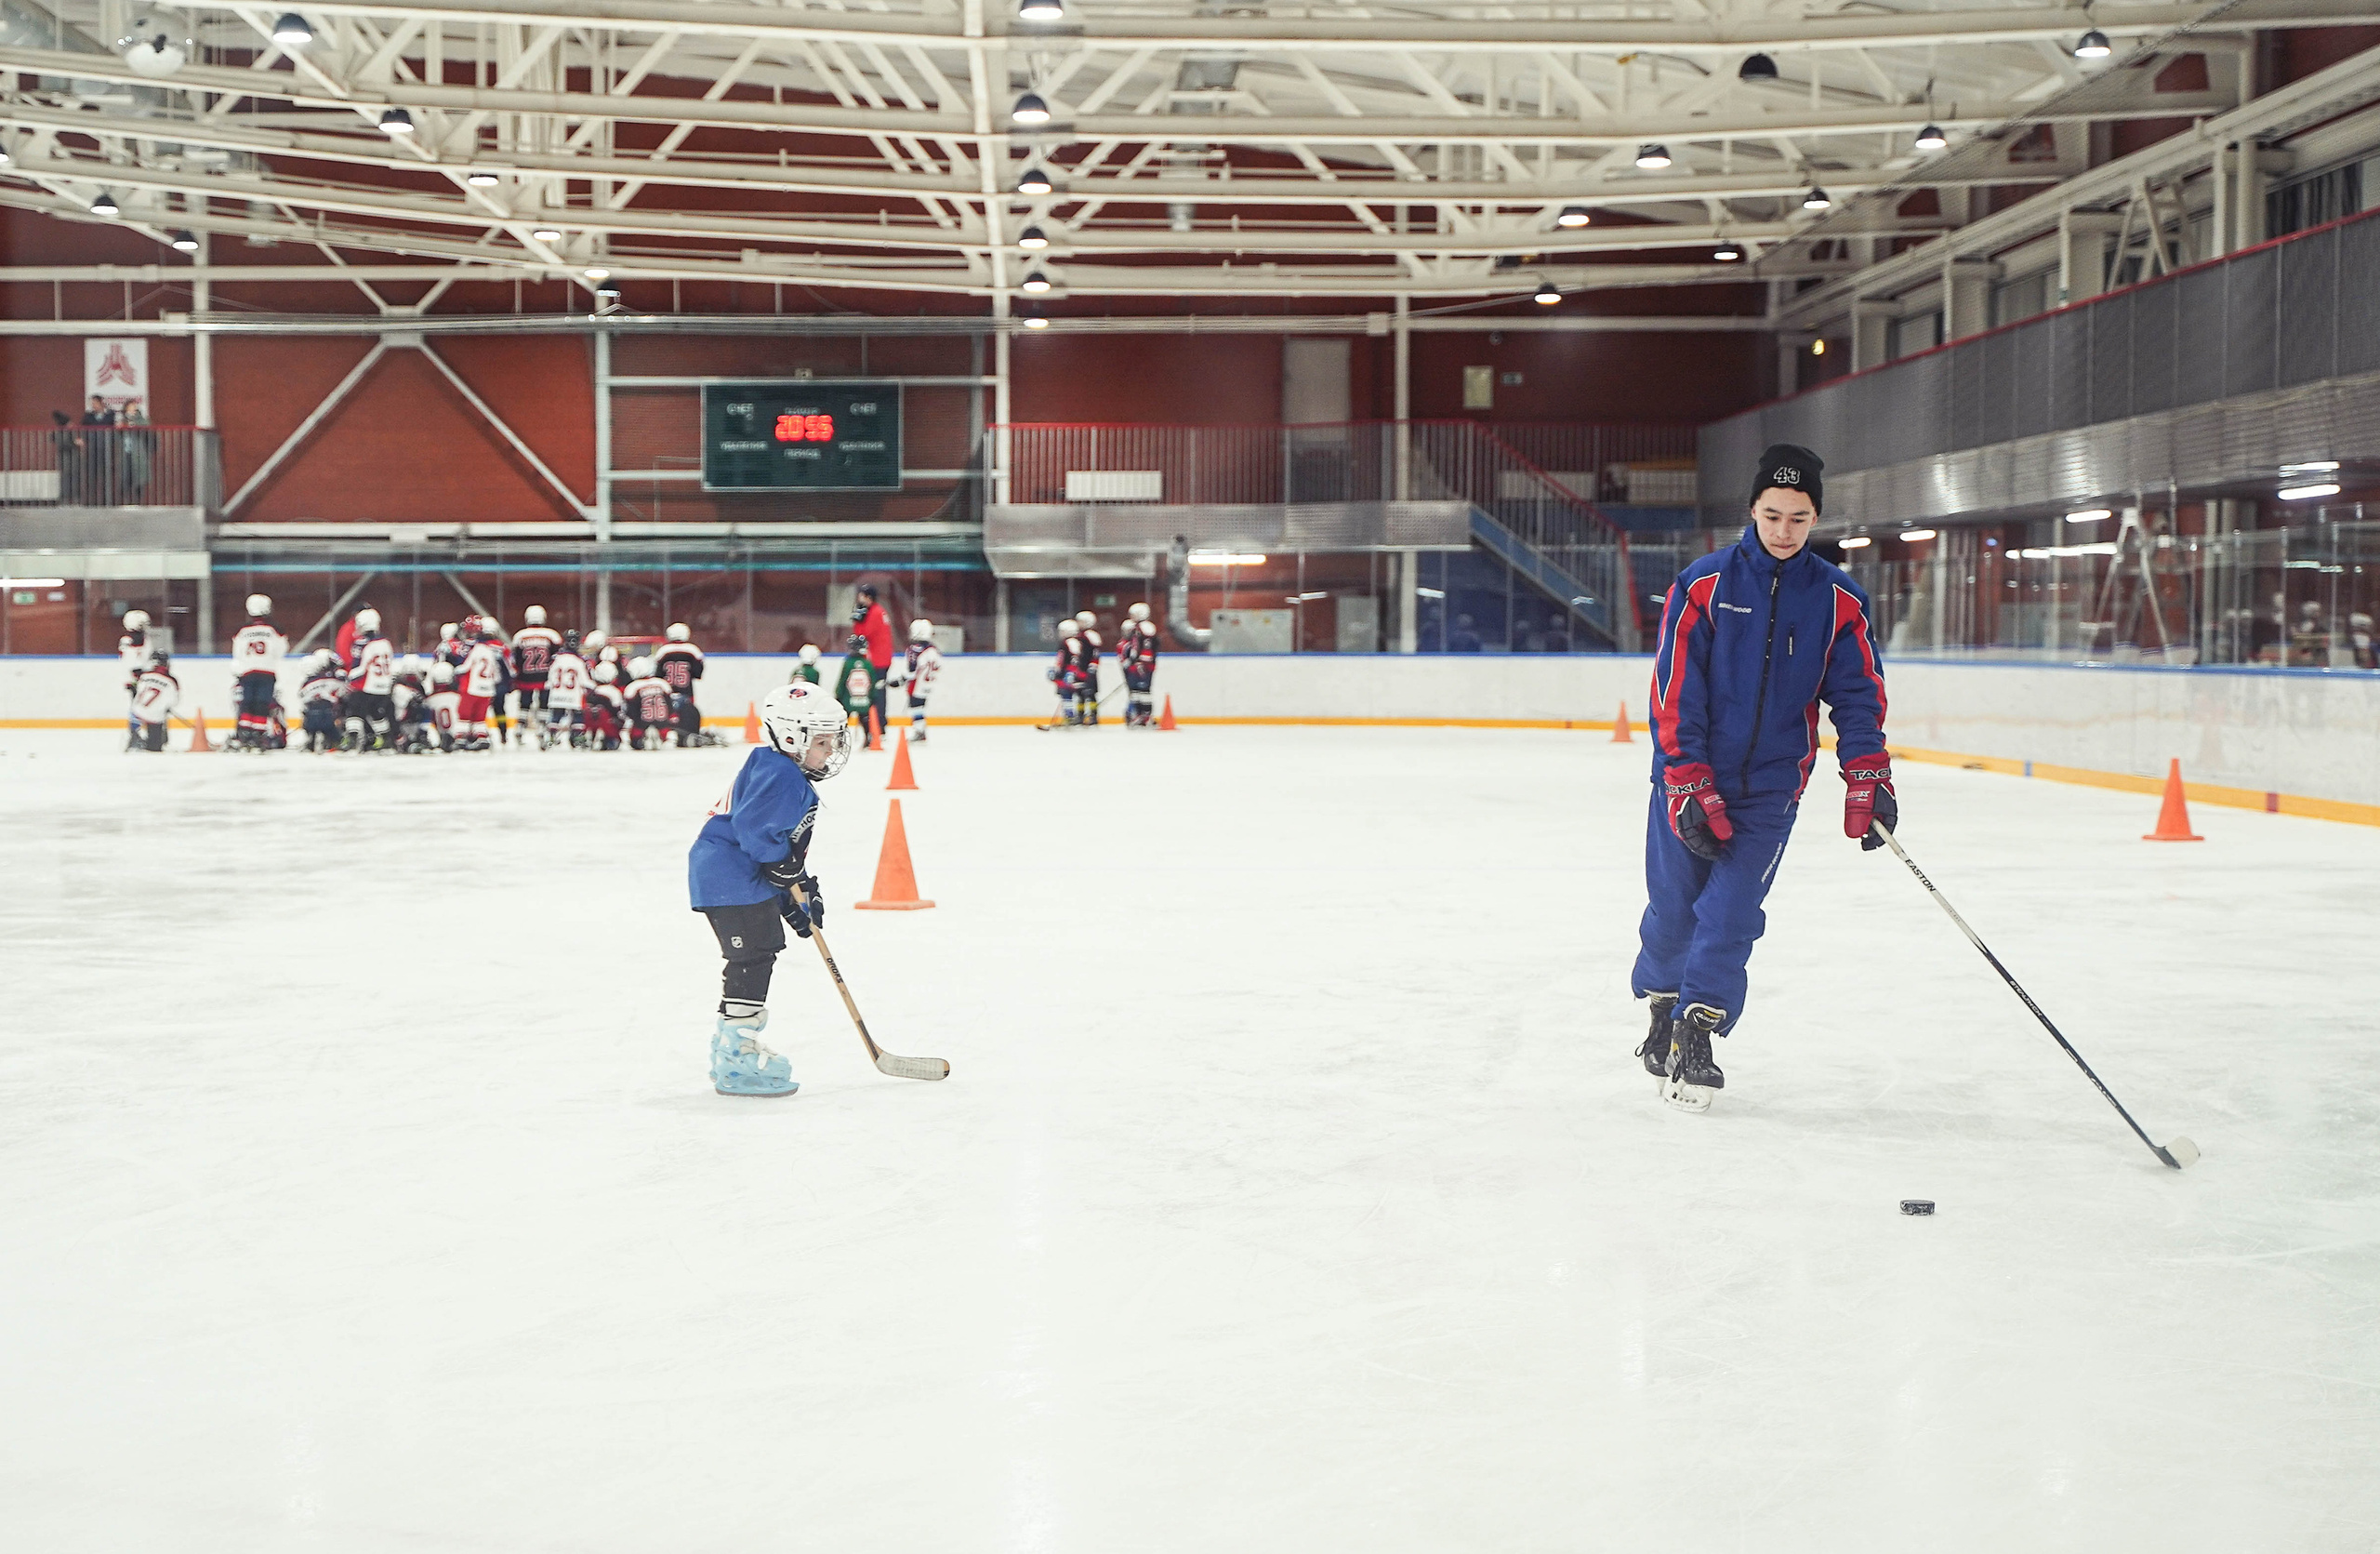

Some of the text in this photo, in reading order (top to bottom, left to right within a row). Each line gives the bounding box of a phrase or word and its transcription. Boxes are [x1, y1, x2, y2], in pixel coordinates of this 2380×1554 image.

[1773, 466, 1801, 485] 43
[522, 646, 549, 673] 22
[663, 661, 691, 688] 35
[1905, 857, 1936, 893] EASTON
